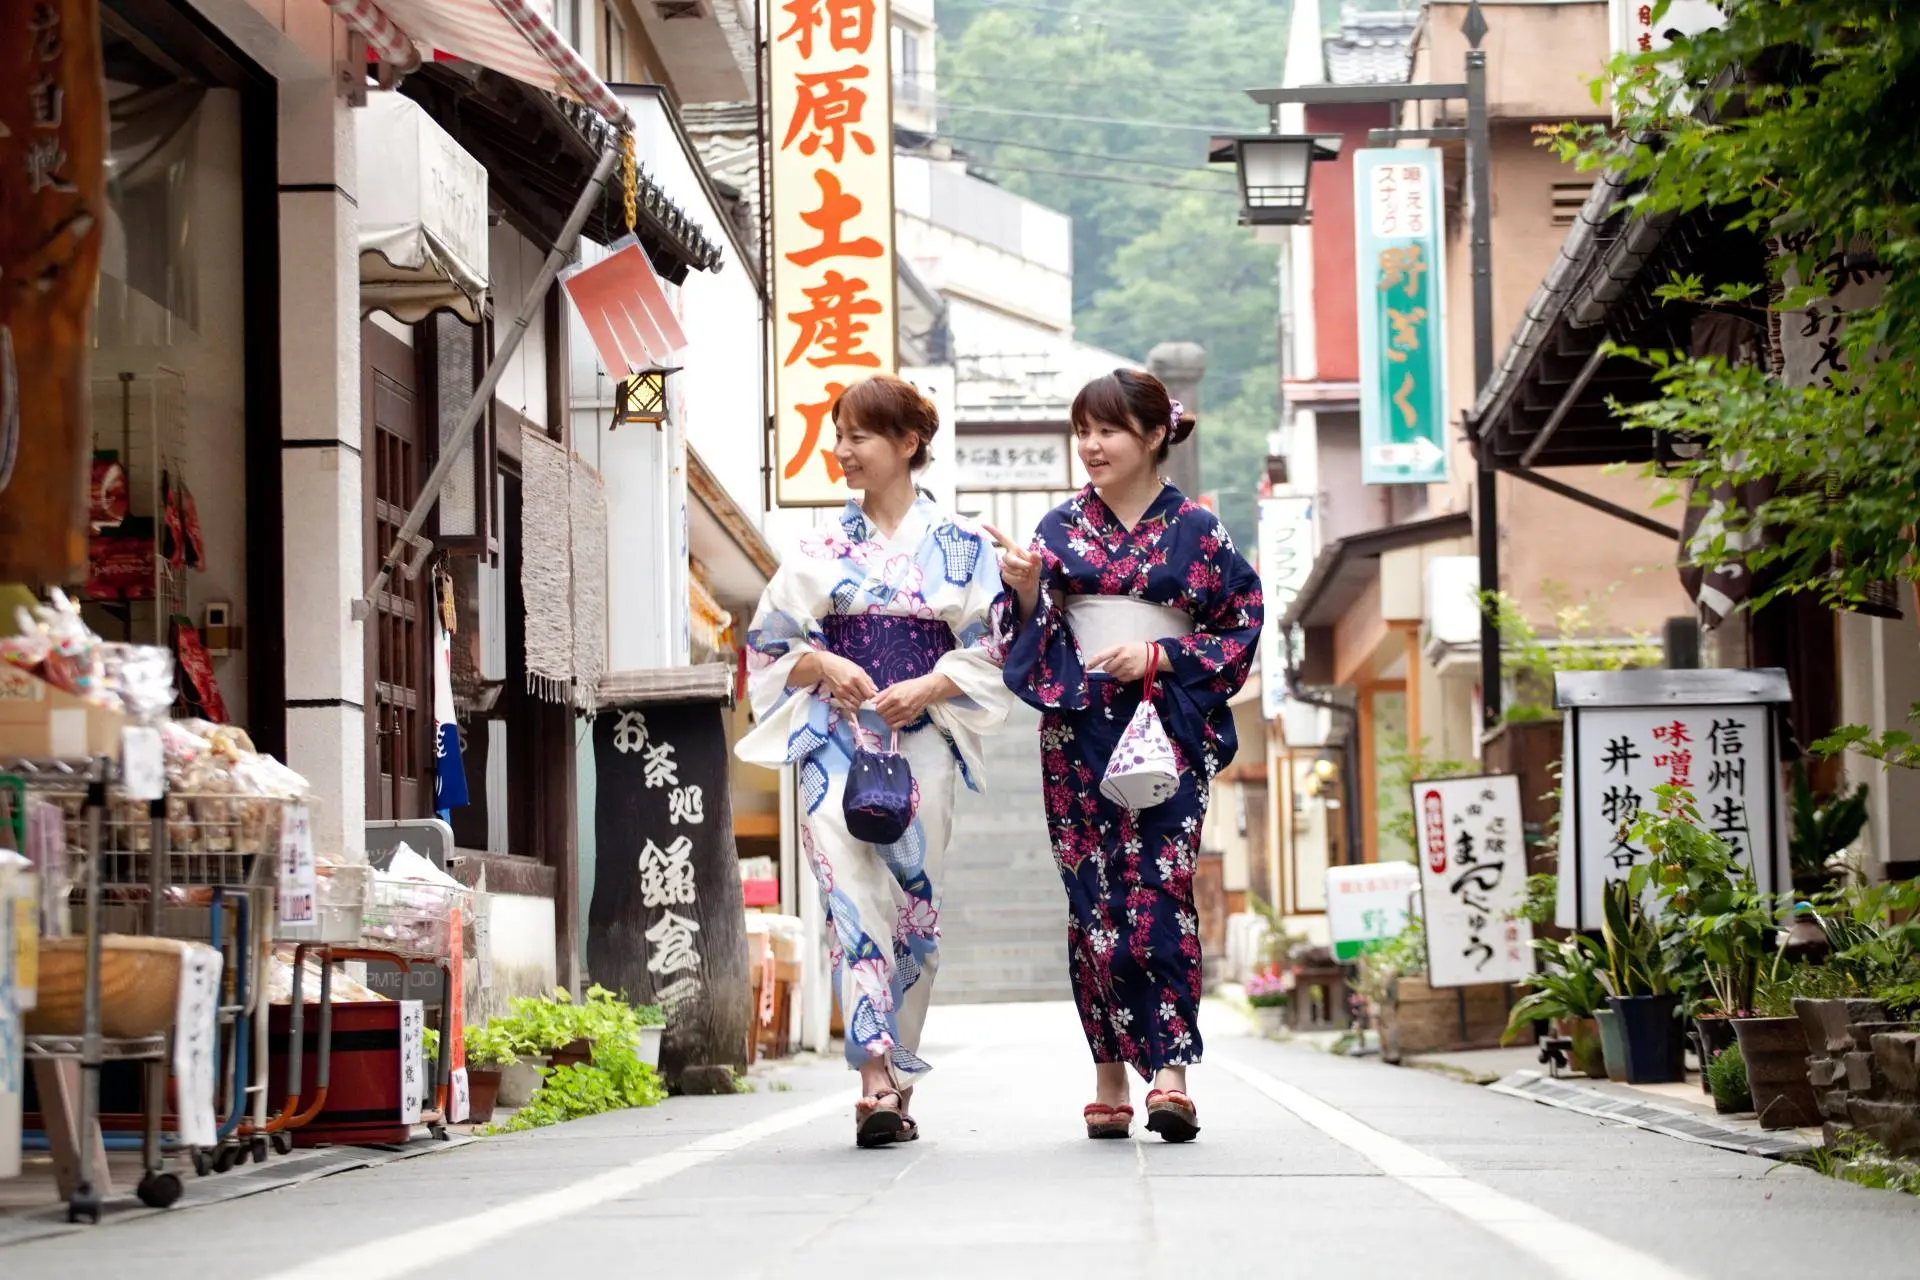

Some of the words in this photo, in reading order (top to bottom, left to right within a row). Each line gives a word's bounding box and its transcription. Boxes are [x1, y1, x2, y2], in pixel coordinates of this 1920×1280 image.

[1378, 166, 1398, 234] スナック
[1376, 243, 1428, 429] 野ぎく
[613, 709, 704, 825] お茶処
[1601, 735, 1645, 892] 丼物各
[1706, 717, 1749, 876] 信州生そ
